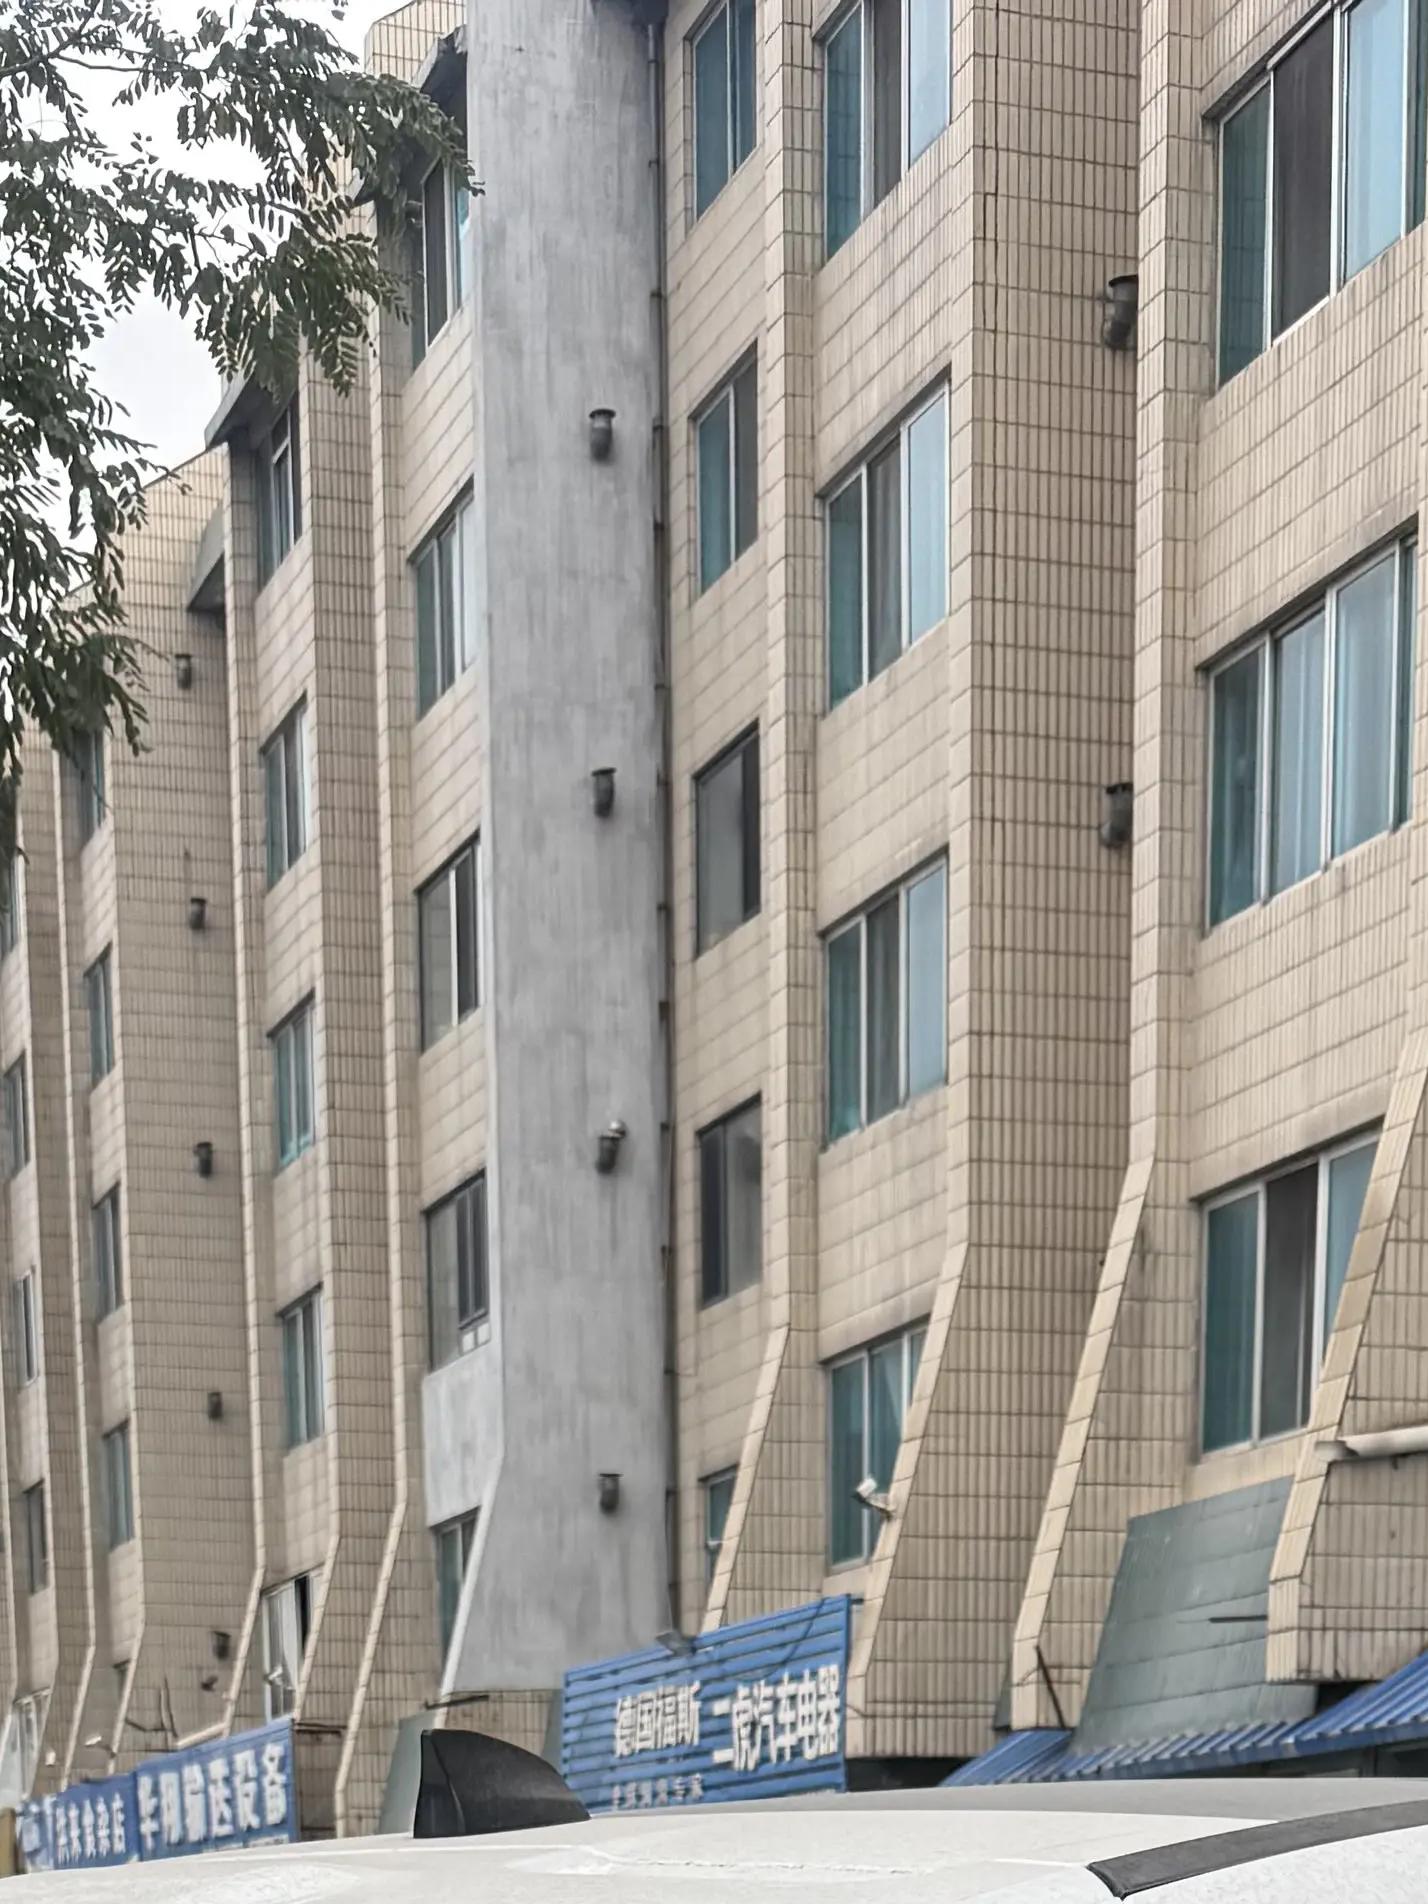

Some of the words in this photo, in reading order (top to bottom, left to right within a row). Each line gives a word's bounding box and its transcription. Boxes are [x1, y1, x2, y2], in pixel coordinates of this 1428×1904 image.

[615, 1680, 700, 1758] 德国福斯
[712, 1664, 840, 1771] 二虎汽车电器
